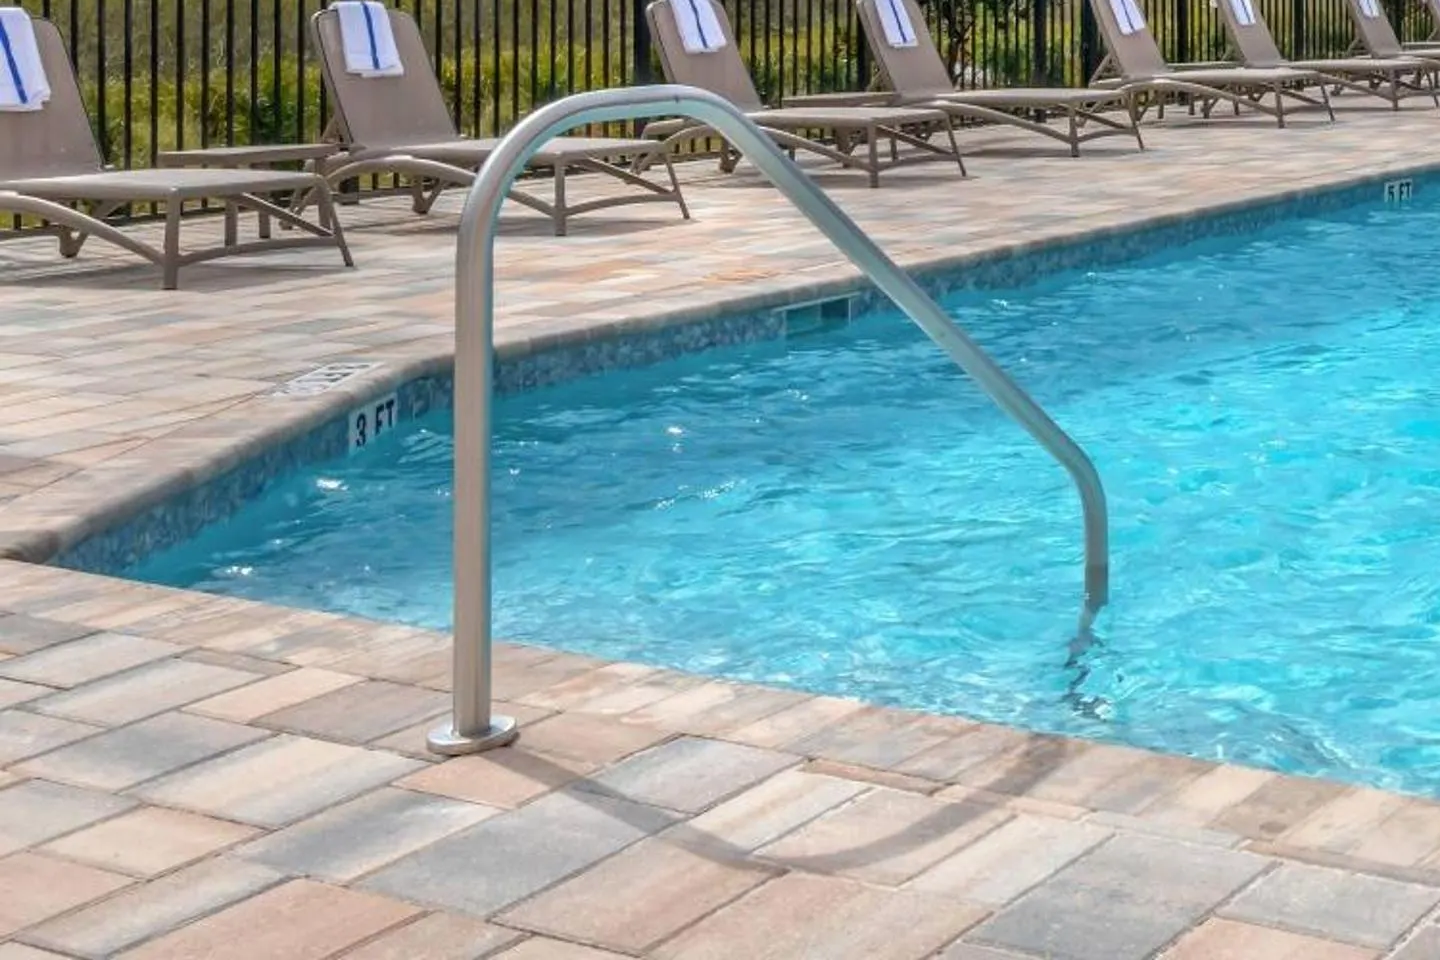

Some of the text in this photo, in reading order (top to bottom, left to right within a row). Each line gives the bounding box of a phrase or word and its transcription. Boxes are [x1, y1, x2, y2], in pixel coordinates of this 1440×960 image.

[1388, 181, 1411, 202] 5 FT
[356, 398, 395, 447] 3 FT
